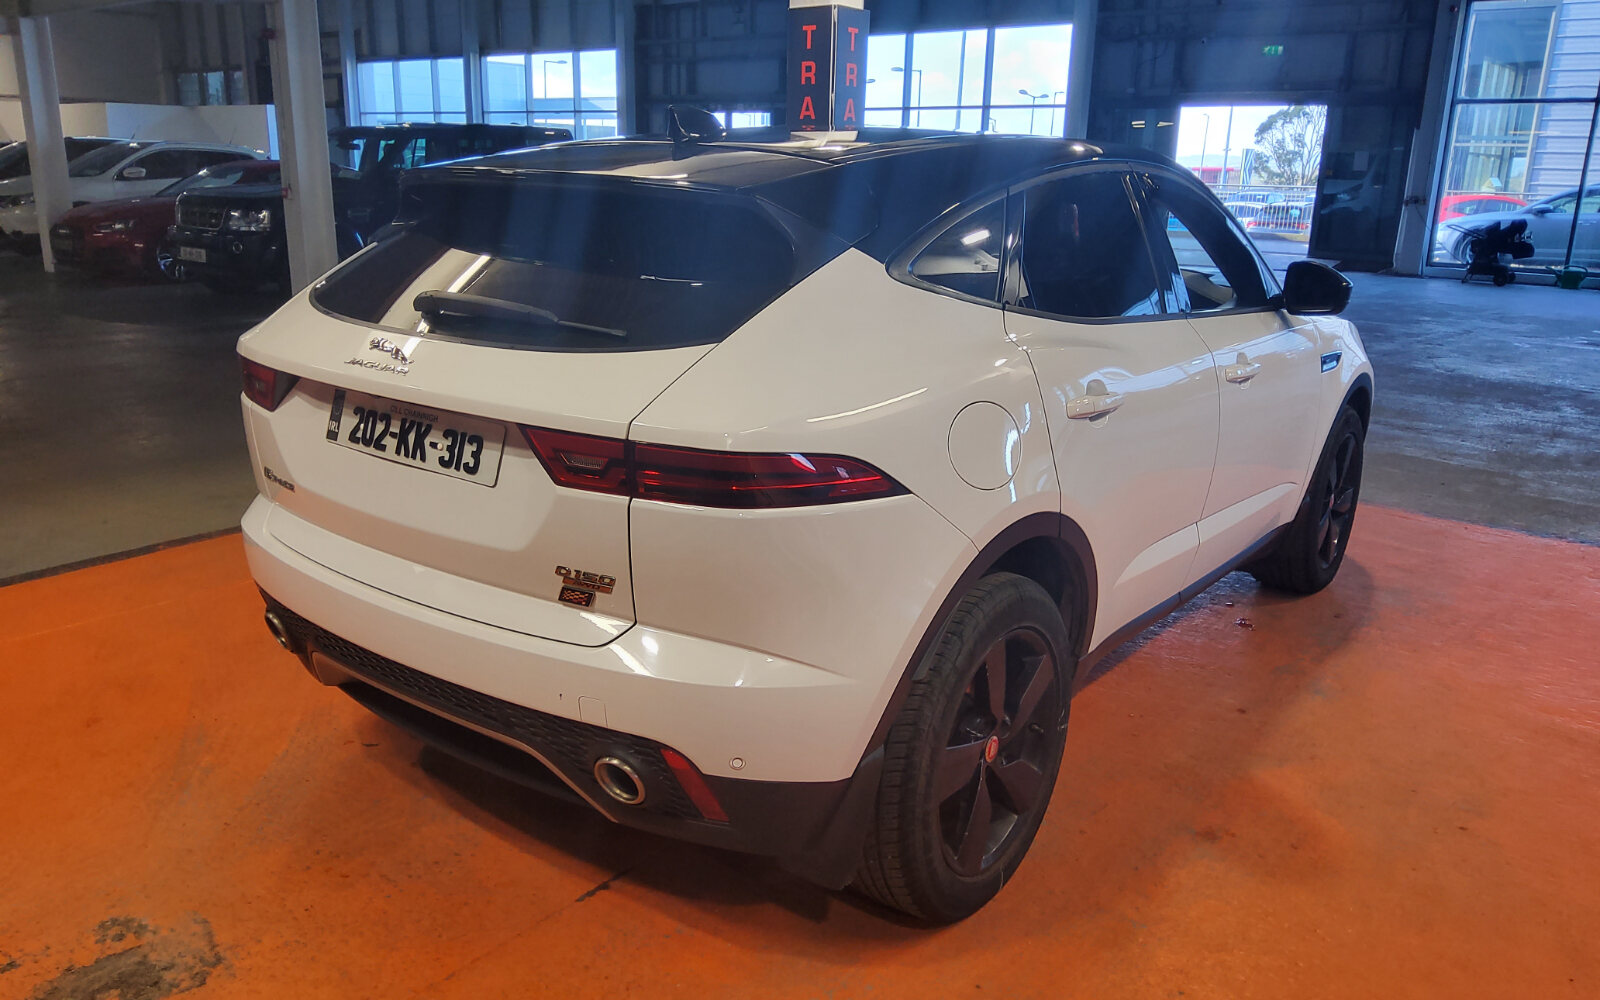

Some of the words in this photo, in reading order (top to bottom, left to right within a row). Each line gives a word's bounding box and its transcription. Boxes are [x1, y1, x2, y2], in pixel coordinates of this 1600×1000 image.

[344, 357, 410, 376] JAGUAR
[328, 419, 340, 433] IRL
[348, 406, 484, 475] 202-KK-313
